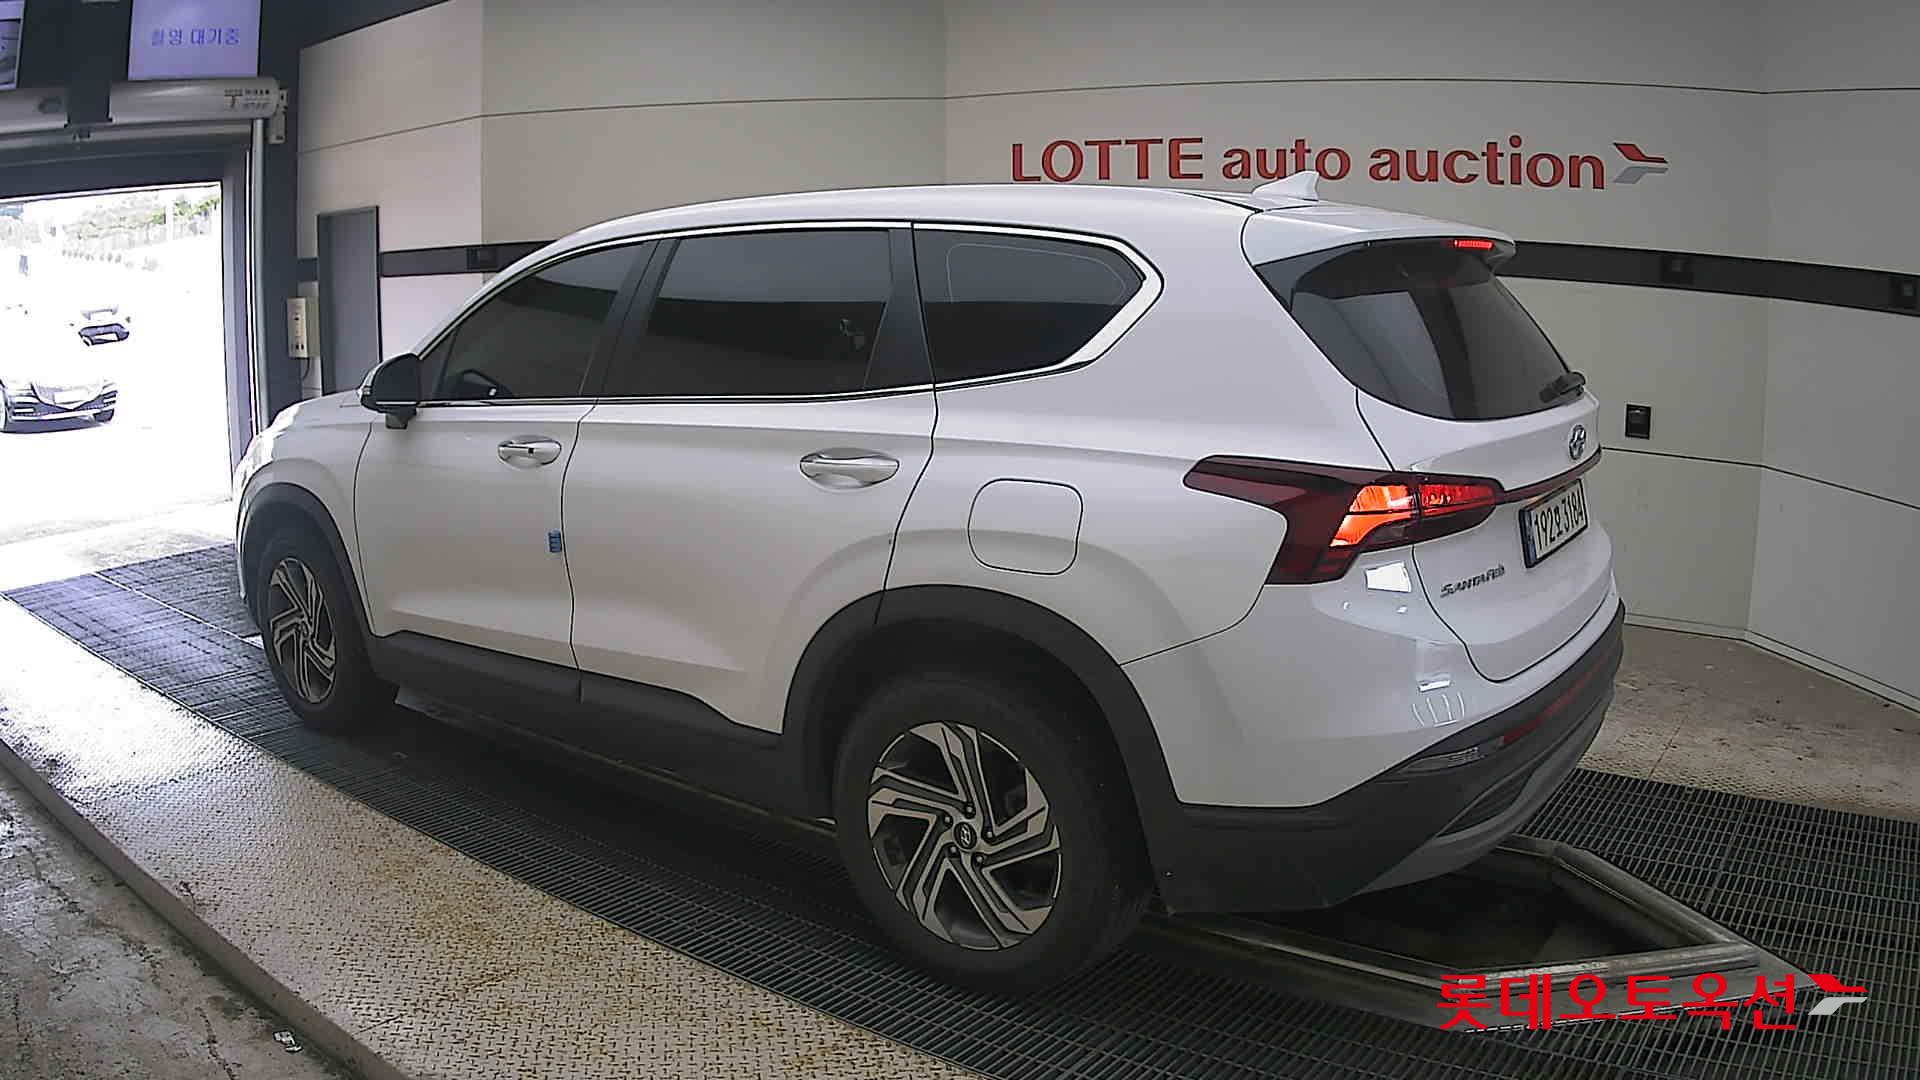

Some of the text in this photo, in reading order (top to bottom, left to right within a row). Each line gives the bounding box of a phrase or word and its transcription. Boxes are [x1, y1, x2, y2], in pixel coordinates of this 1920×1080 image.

[191, 27, 239, 45] 대기중
[1010, 135, 1606, 190] LOTTE auto auction
